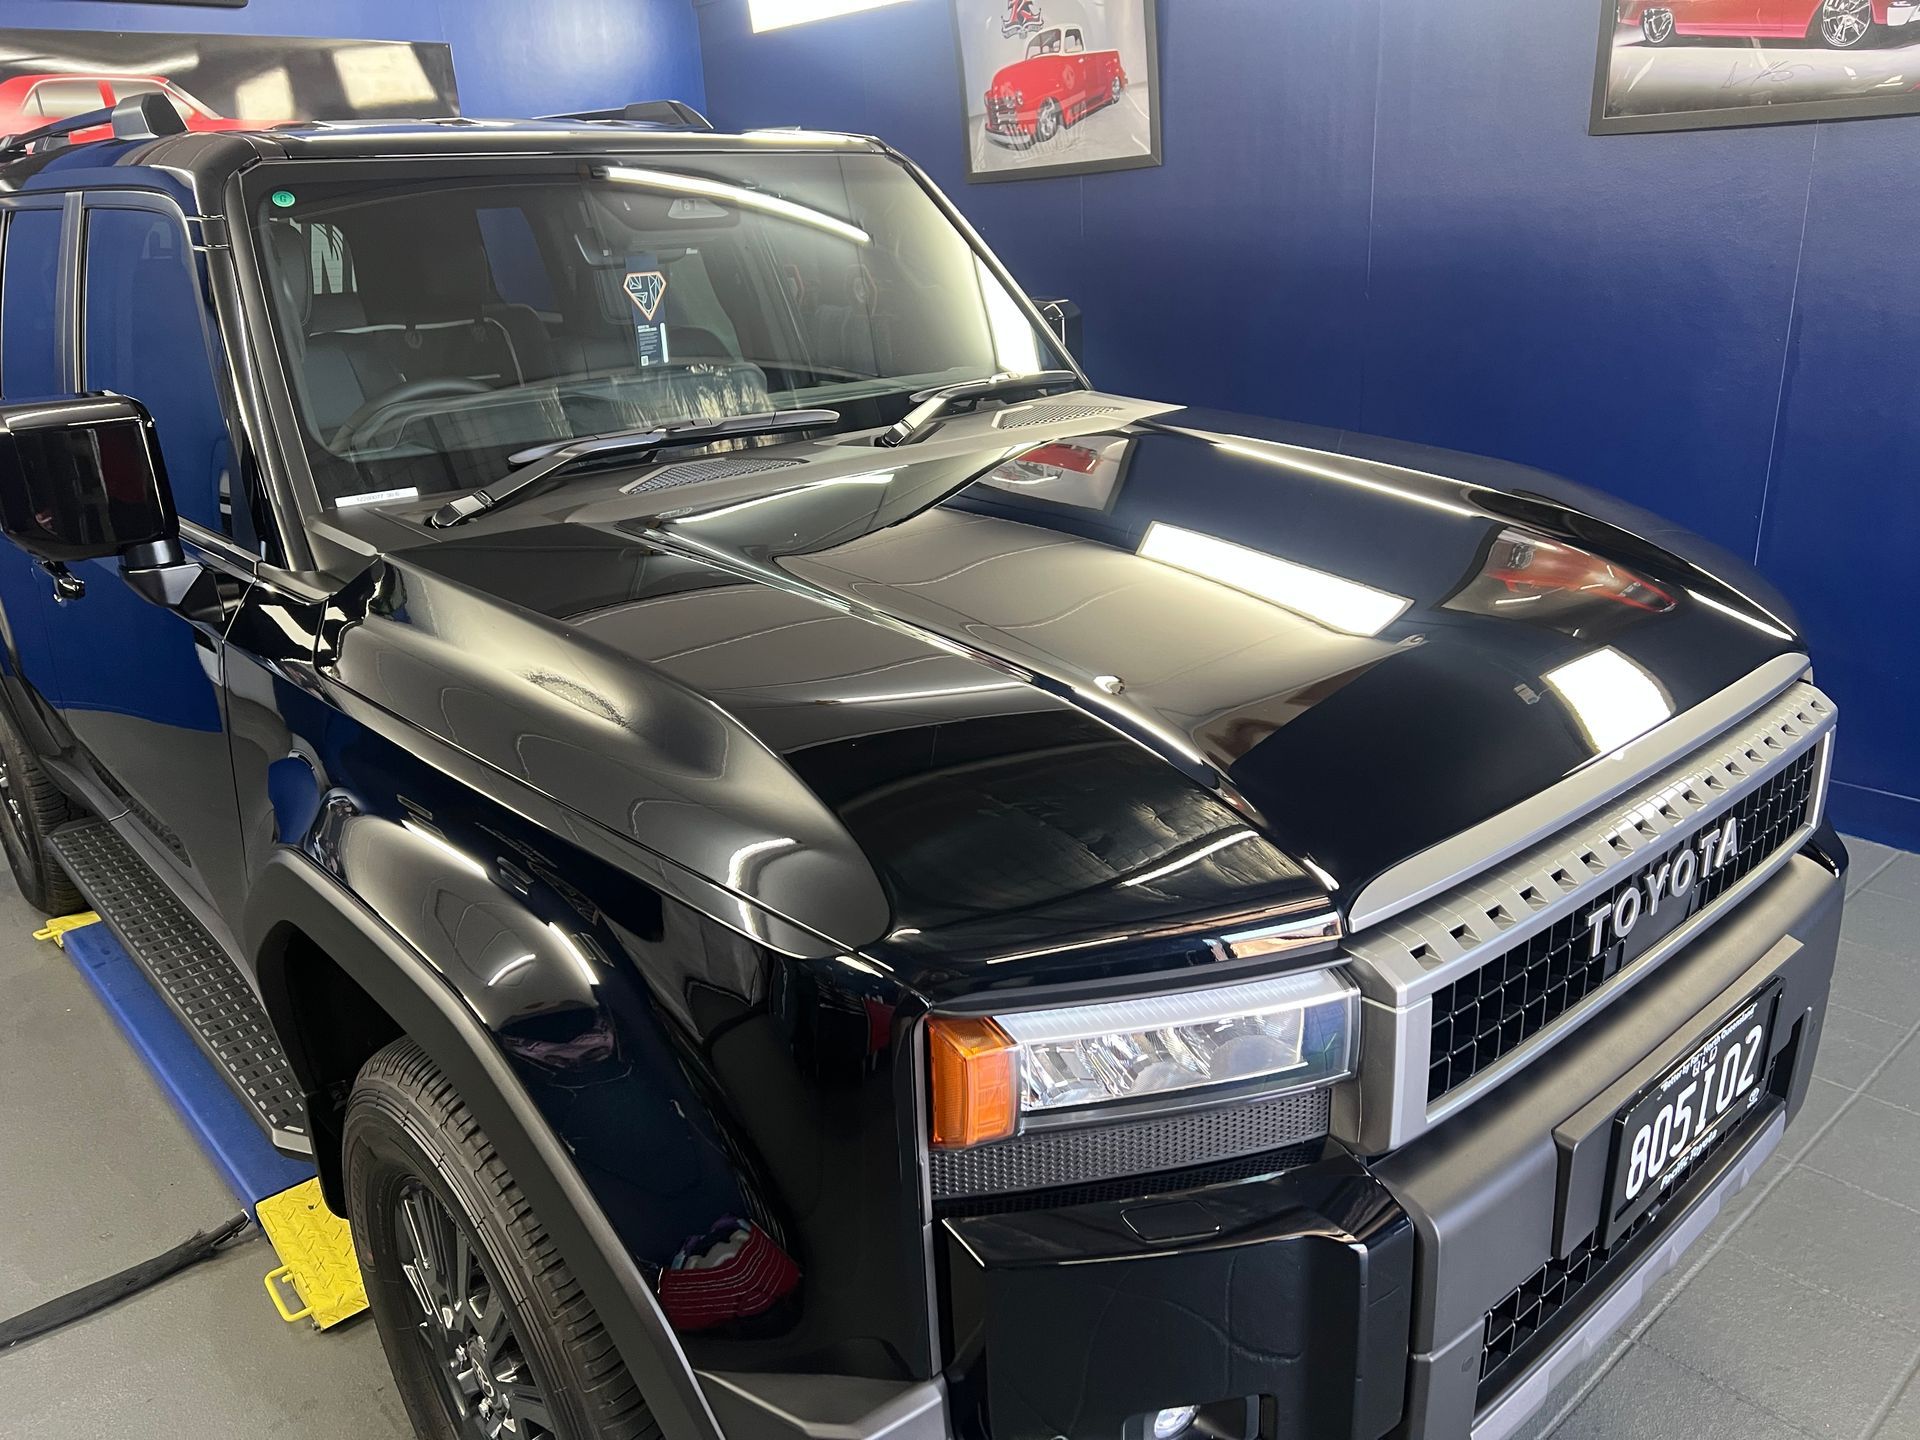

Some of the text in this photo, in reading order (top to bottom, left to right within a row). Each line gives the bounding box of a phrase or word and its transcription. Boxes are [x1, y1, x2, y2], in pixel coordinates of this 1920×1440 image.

[1586, 816, 1738, 958] TOYOTA
[1692, 1045, 1718, 1078] QLD
[1659, 1128, 1718, 1191] Pacific Toyota
